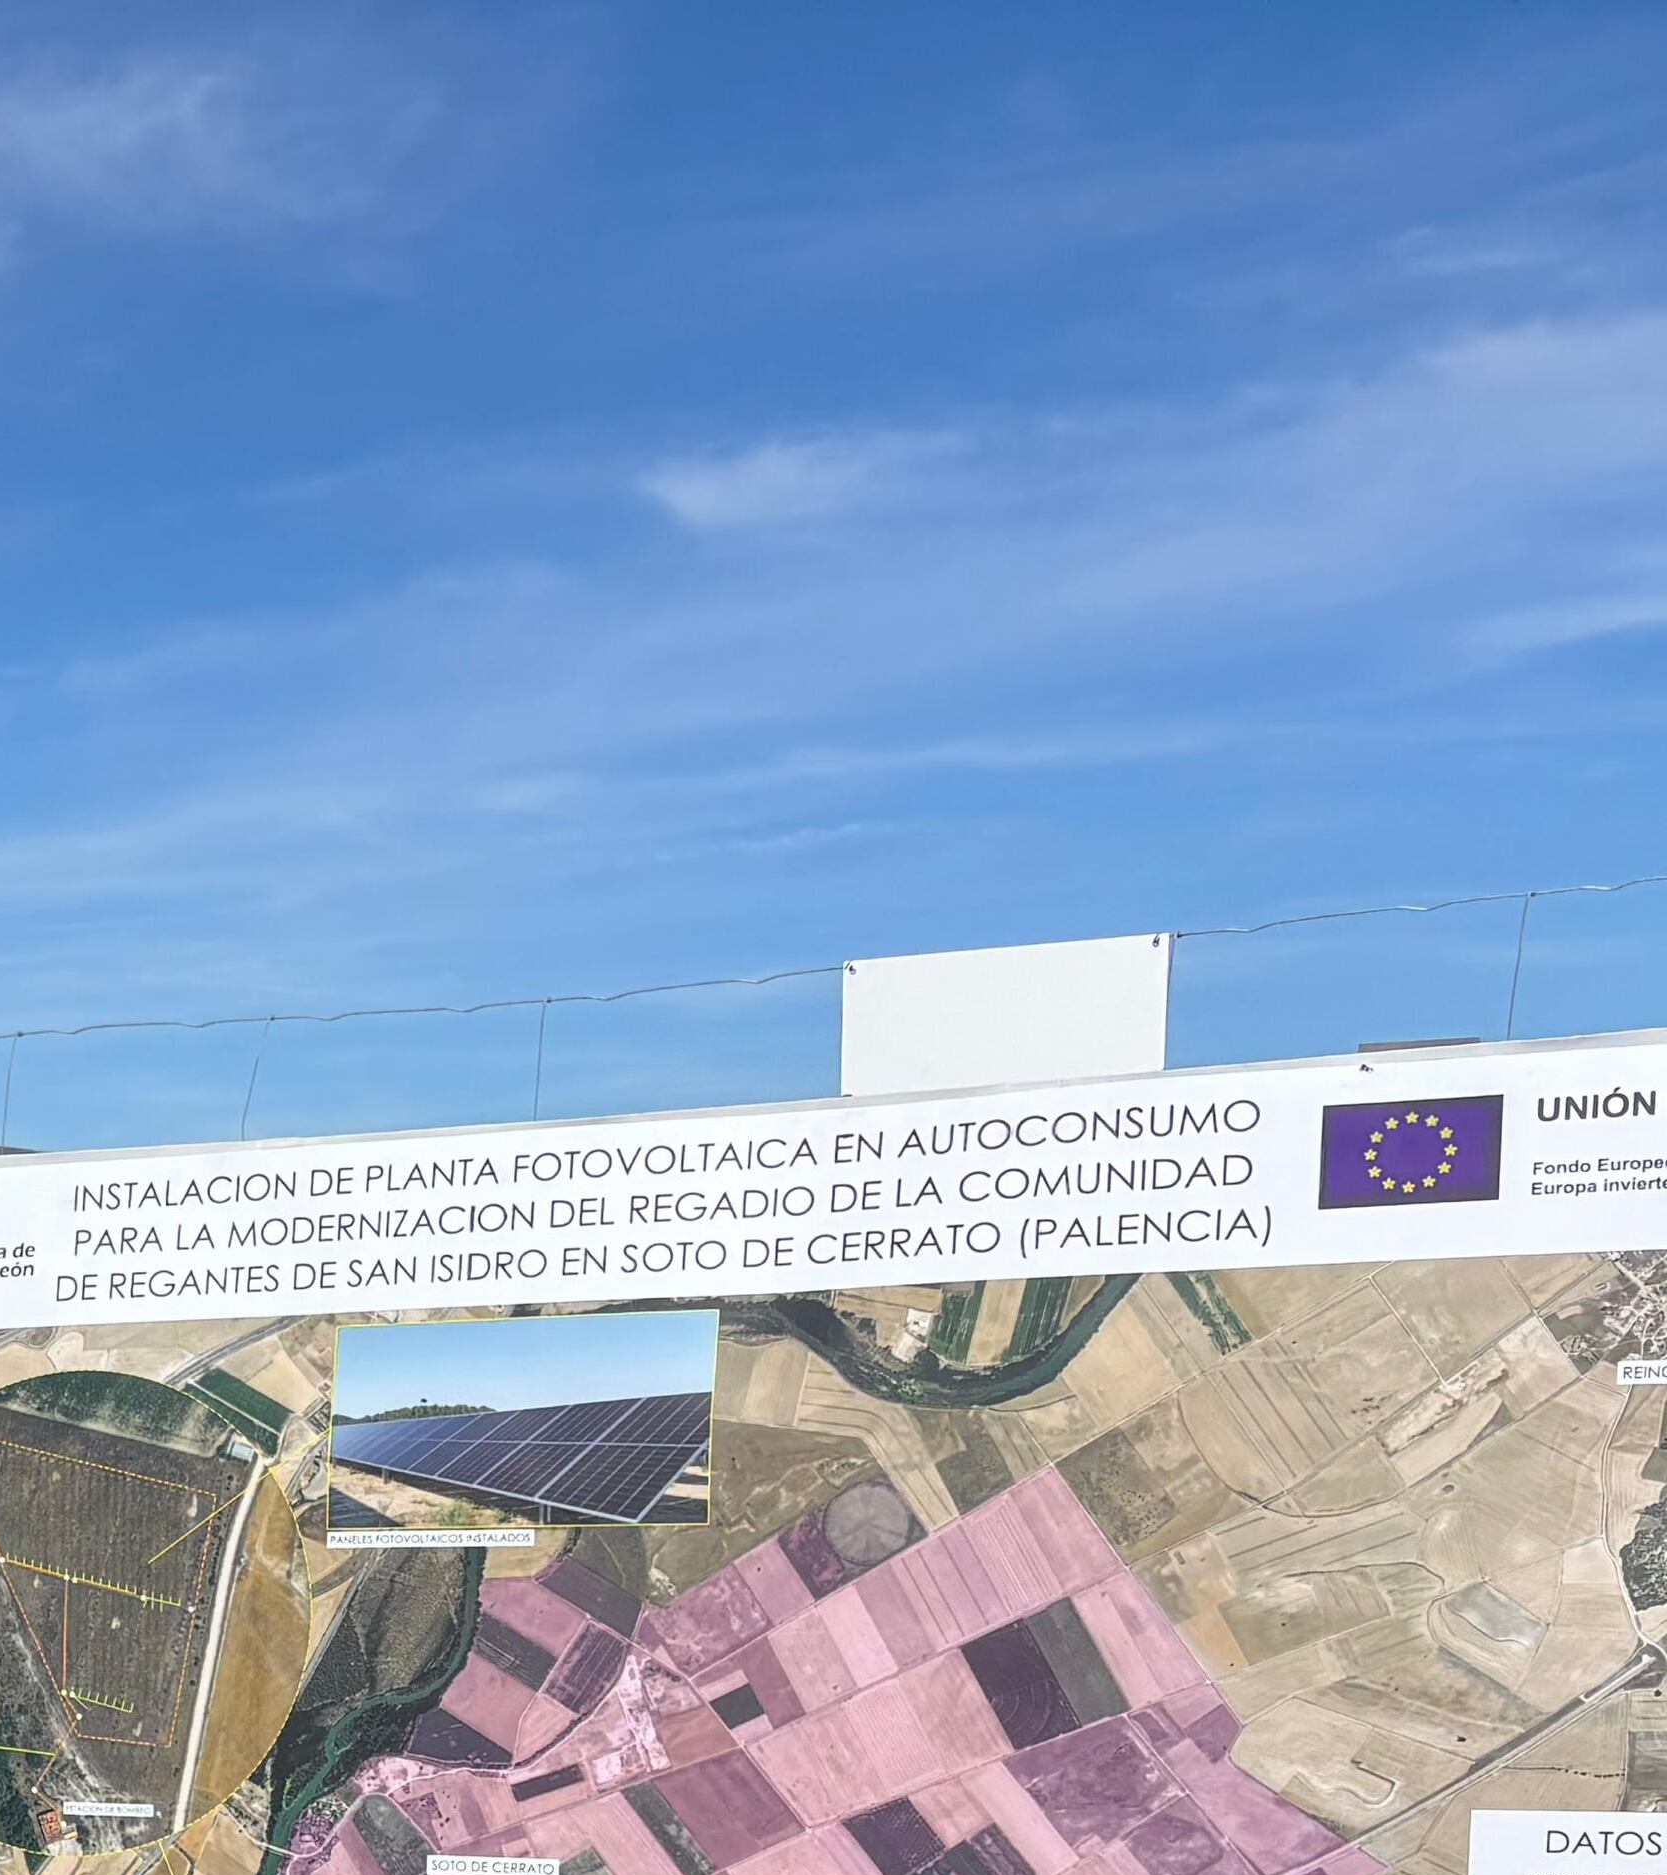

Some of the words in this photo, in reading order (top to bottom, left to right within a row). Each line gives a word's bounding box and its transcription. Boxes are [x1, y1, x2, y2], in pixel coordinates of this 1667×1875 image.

[1537, 1086, 1656, 1122] UNIÓN
[75, 1172, 295, 1211] INSTALACION
[311, 1168, 353, 1196] DE
[366, 1159, 498, 1192] PLANTA
[514, 1138, 817, 1182] FOTOVOLTAICA
[835, 1132, 883, 1163] EN
[898, 1100, 1260, 1157] AUTOCONSUMO
[1533, 1159, 1591, 1175] Fondo
[1531, 1182, 1597, 1196] Europa
[75, 1227, 162, 1255] PARA
[177, 1224, 214, 1250] LA
[228, 1202, 534, 1247] MODERNIZACION
[551, 1197, 615, 1228] DEL
[630, 1187, 814, 1223] REGADIO
[831, 1181, 881, 1212] DE
[896, 1177, 942, 1207] LA
[960, 1155, 1252, 1201] COMUNIDAD
[12, 1243, 35, 1259] de
[57, 1275, 97, 1301] DE
[110, 1265, 278, 1298] REGANTES
[294, 1262, 336, 1290] DE
[348, 1257, 416, 1287] SAN
[431, 1250, 547, 1282] ISIDRO
[563, 1246, 606, 1275] EN
[622, 1241, 726, 1272] SOTO
[744, 1237, 793, 1267] DE
[808, 1222, 1000, 1264] CERRATO
[1021, 1206, 1270, 1258] (PALENCIA)
[330, 1535, 372, 1544] PANELES
[376, 1533, 463, 1544] FOTOVOLTAICOS
[467, 1533, 530, 1543] INSTALADOS
[1546, 1830, 1662, 1856] DATOS
[432, 1859, 467, 1872] SOTO
[471, 1860, 488, 1873] DE
[492, 1861, 554, 1875] CERRATO
